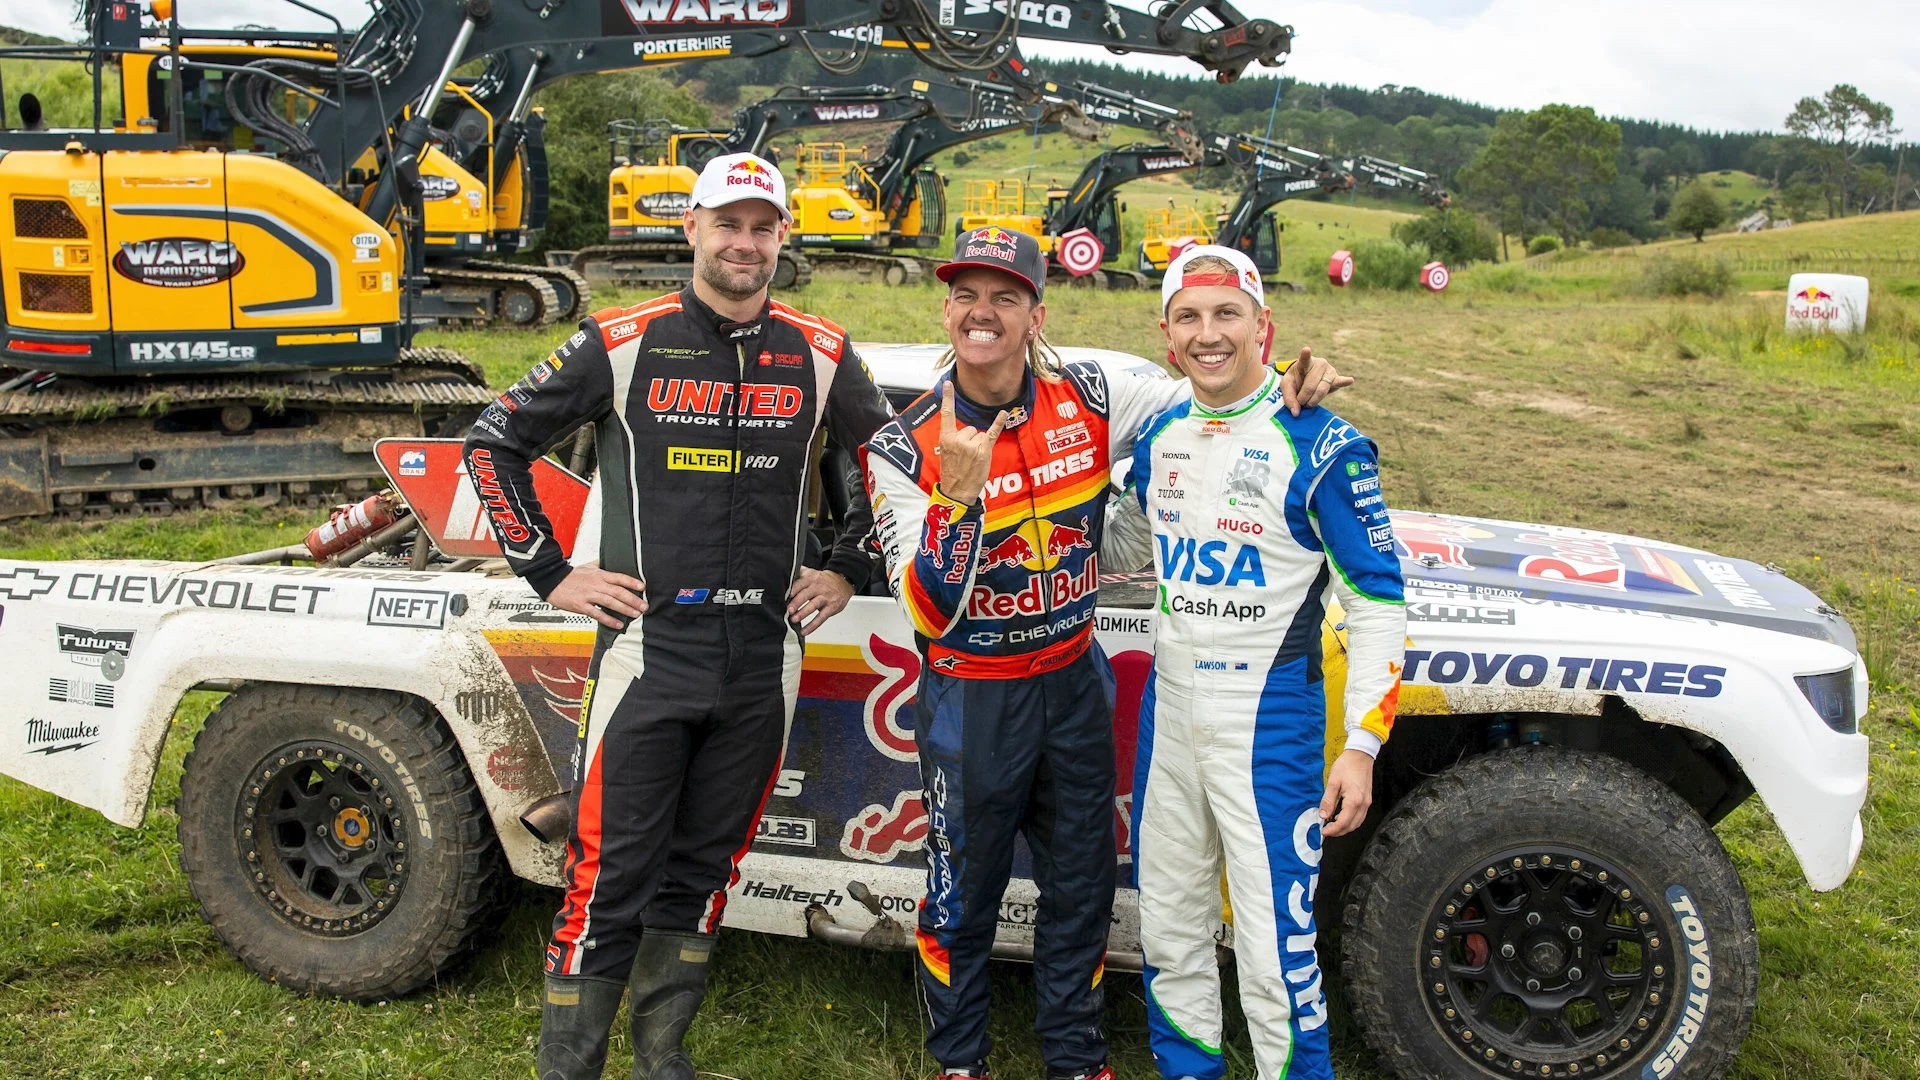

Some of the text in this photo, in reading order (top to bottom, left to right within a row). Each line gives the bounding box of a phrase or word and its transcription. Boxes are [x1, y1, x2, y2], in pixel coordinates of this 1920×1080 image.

[634, 35, 732, 55] PORTERHIRE
[814, 105, 879, 121] WARD
[727, 174, 774, 195] Red Bull
[641, 194, 692, 209] WAR
[120, 241, 237, 267] WARD
[965, 244, 1015, 262] Red Bull
[143, 266, 217, 278] DEMOLITION
[1790, 305, 1838, 319] Red Bull
[610, 323, 638, 338] OMP
[814, 334, 838, 350] OMP
[130, 340, 256, 363] HX145CR
[647, 378, 803, 418] UNITED
[655, 415, 787, 429] TRUCK PARTS
[673, 453, 779, 469] FILTER PRO
[1162, 452, 1190, 460] HONDA
[1243, 447, 1269, 461] VISA
[1029, 449, 1093, 487] TIRES
[472, 448, 530, 543] UNITED
[1158, 489, 1184, 499] TUDOR
[1158, 509, 1180, 523] Mobil
[1217, 518, 1263, 535] HUGO
[945, 523, 976, 585] Red Bull
[1155, 534, 1266, 587] VISA
[316, 569, 442, 583] TIRES
[67, 573, 331, 615] CHEVROLET
[967, 551, 1099, 620] Red Bull
[1476, 587, 1523, 599] ROTARY
[376, 597, 438, 620] NEFT
[488, 601, 549, 613] Hampton
[1172, 595, 1266, 622] Cash App
[1094, 616, 1149, 634] ADMIKE
[1195, 660, 1226, 670] LAWSON
[1401, 650, 1727, 697] TOYO TIRES
[25, 717, 100, 744] Milwaukee
[333, 719, 432, 840] TOYO TIRES
[742, 880, 843, 906] Haltech
[874, 895, 916, 913] OTO
[1652, 895, 1711, 1080] TOYO TIRES
